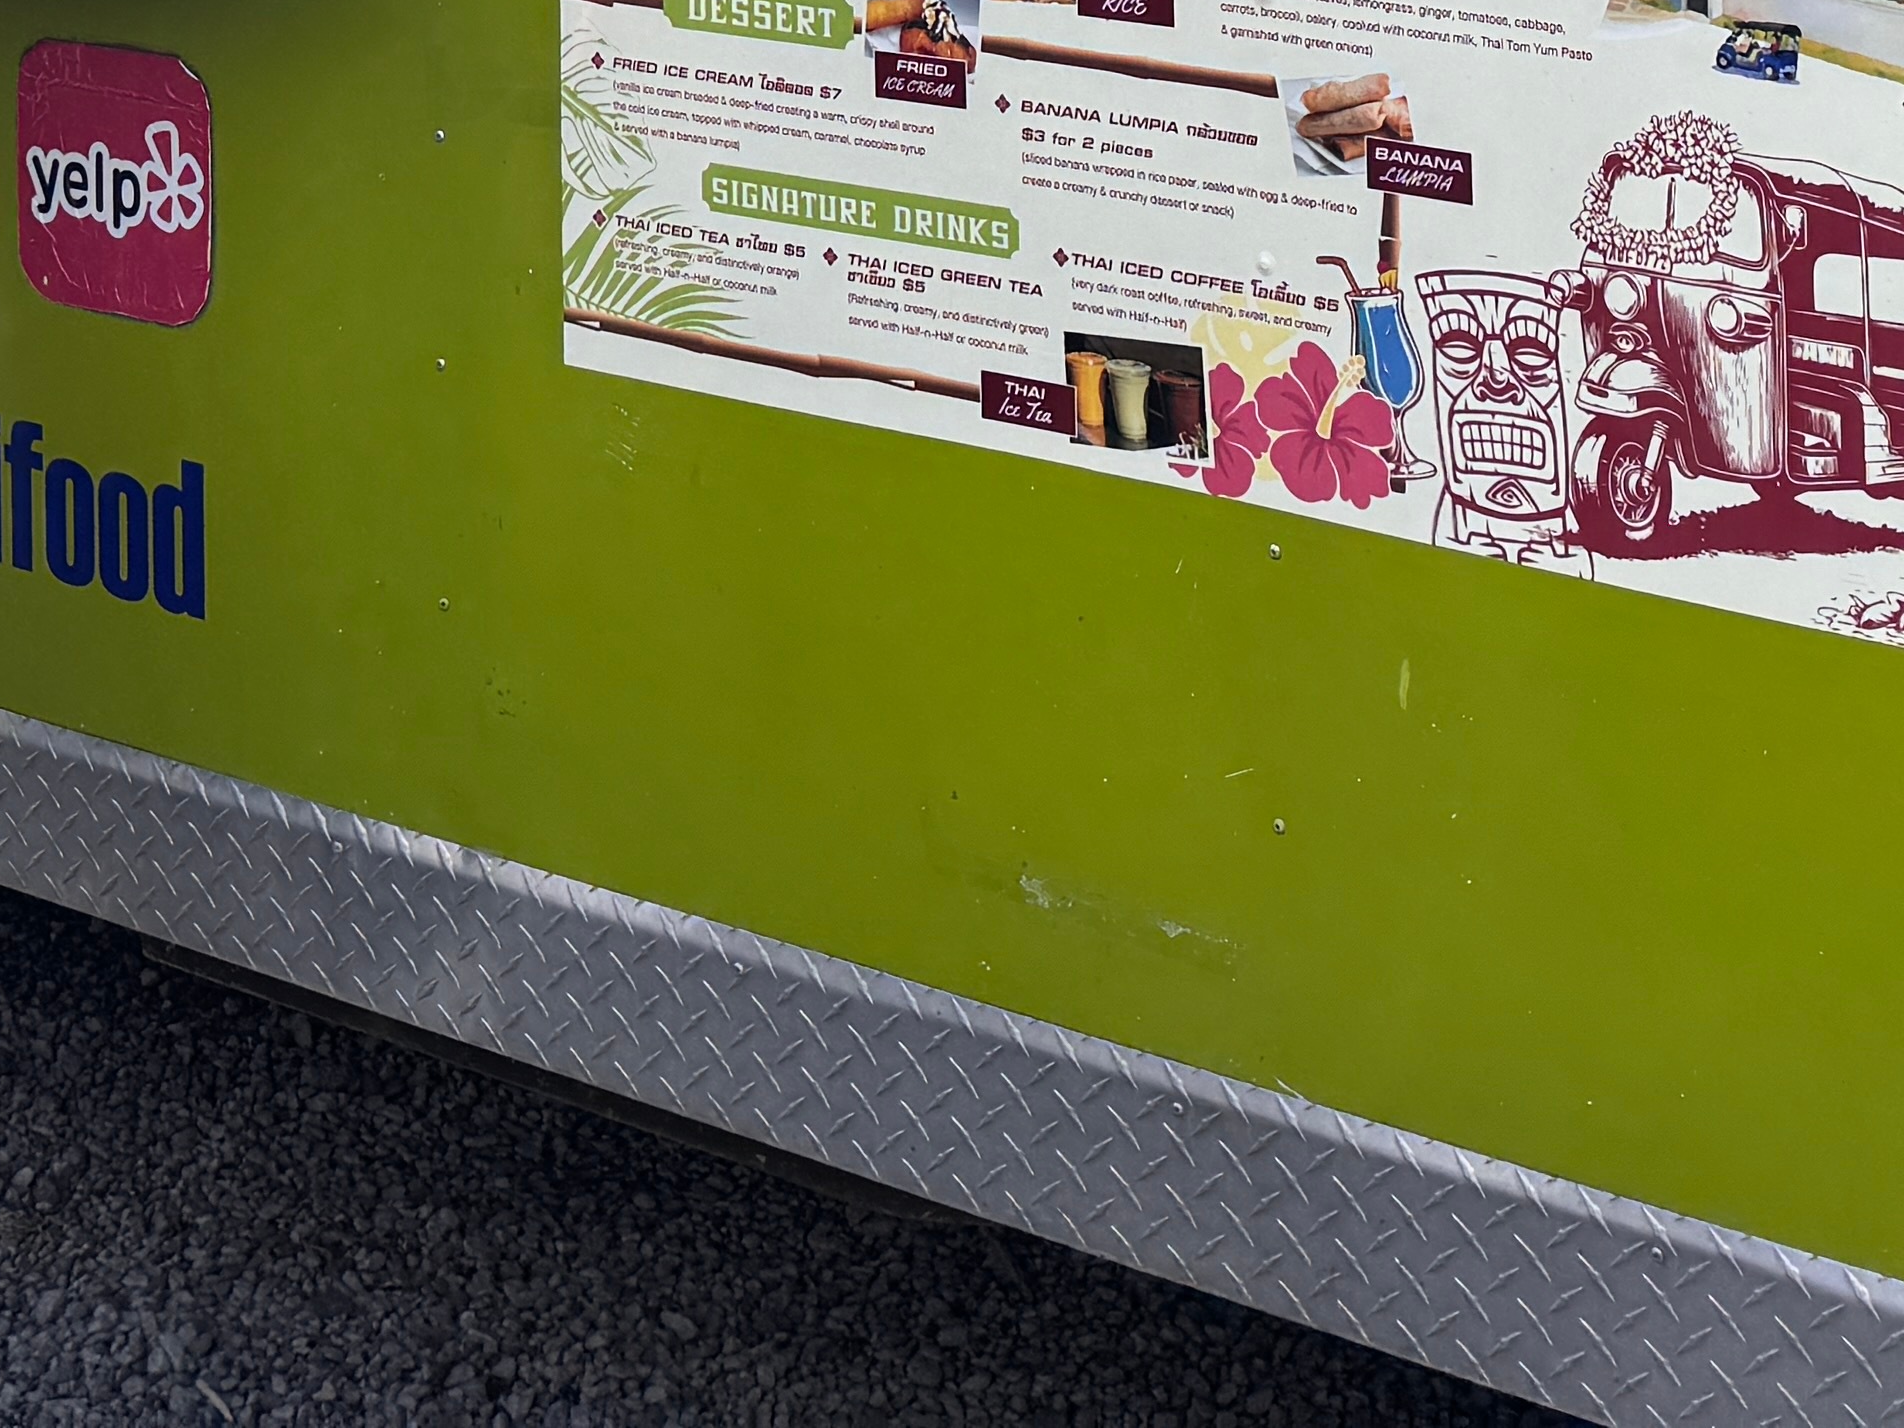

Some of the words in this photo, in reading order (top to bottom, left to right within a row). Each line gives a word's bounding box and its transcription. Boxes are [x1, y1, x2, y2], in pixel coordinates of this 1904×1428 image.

[613, 57, 658, 74] FRIED
[664, 64, 689, 78] ICE
[695, 69, 753, 89] CREAM
[896, 61, 948, 77] FRIED
[883, 77, 903, 92] ICE
[907, 79, 954, 99] CREAM
[1021, 100, 1101, 124] BANANA
[1109, 112, 1179, 136] LUMPIA
[1021, 128, 1046, 143] $3
[1052, 132, 1076, 147] for
[1082, 136, 1095, 149] 2
[1101, 139, 1153, 159] pieces
[1375, 146, 1465, 173] BANANA
[32, 153, 141, 231] yelp
[1379, 168, 1454, 192] LUMPIA
[712, 176, 877, 230] SIGNATURE
[894, 205, 1010, 251] DRINKS
[615, 215, 651, 231] THAI
[656, 221, 693, 238] ICED
[699, 228, 730, 245] TEA
[1071, 252, 1113, 272] THAI
[1120, 259, 1164, 281] ICED
[1170, 266, 1245, 293] COFFEE
[1004, 381, 1046, 399] THAI
